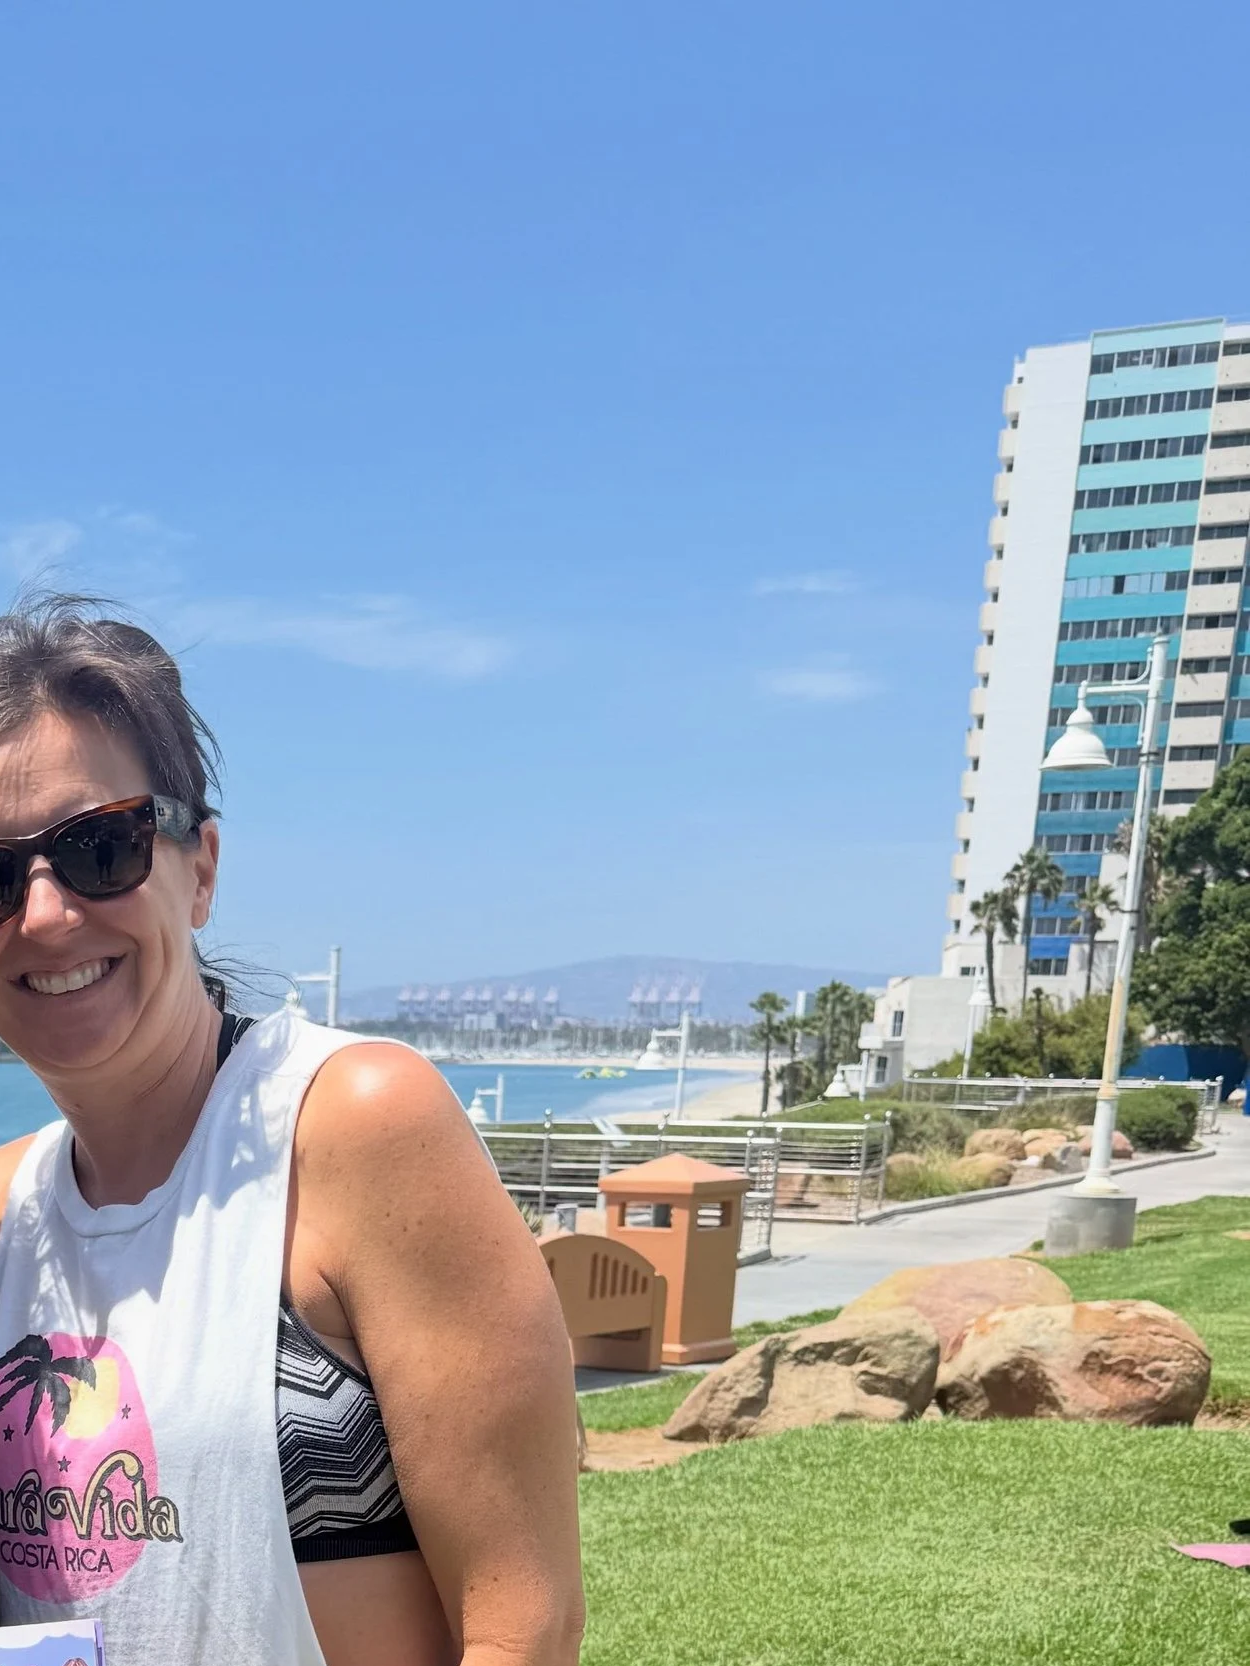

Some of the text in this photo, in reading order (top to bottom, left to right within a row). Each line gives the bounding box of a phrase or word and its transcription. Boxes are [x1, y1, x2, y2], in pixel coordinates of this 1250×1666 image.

[45, 1449, 184, 1543] Vida
[0, 1539, 114, 1573] COSTA RICA
